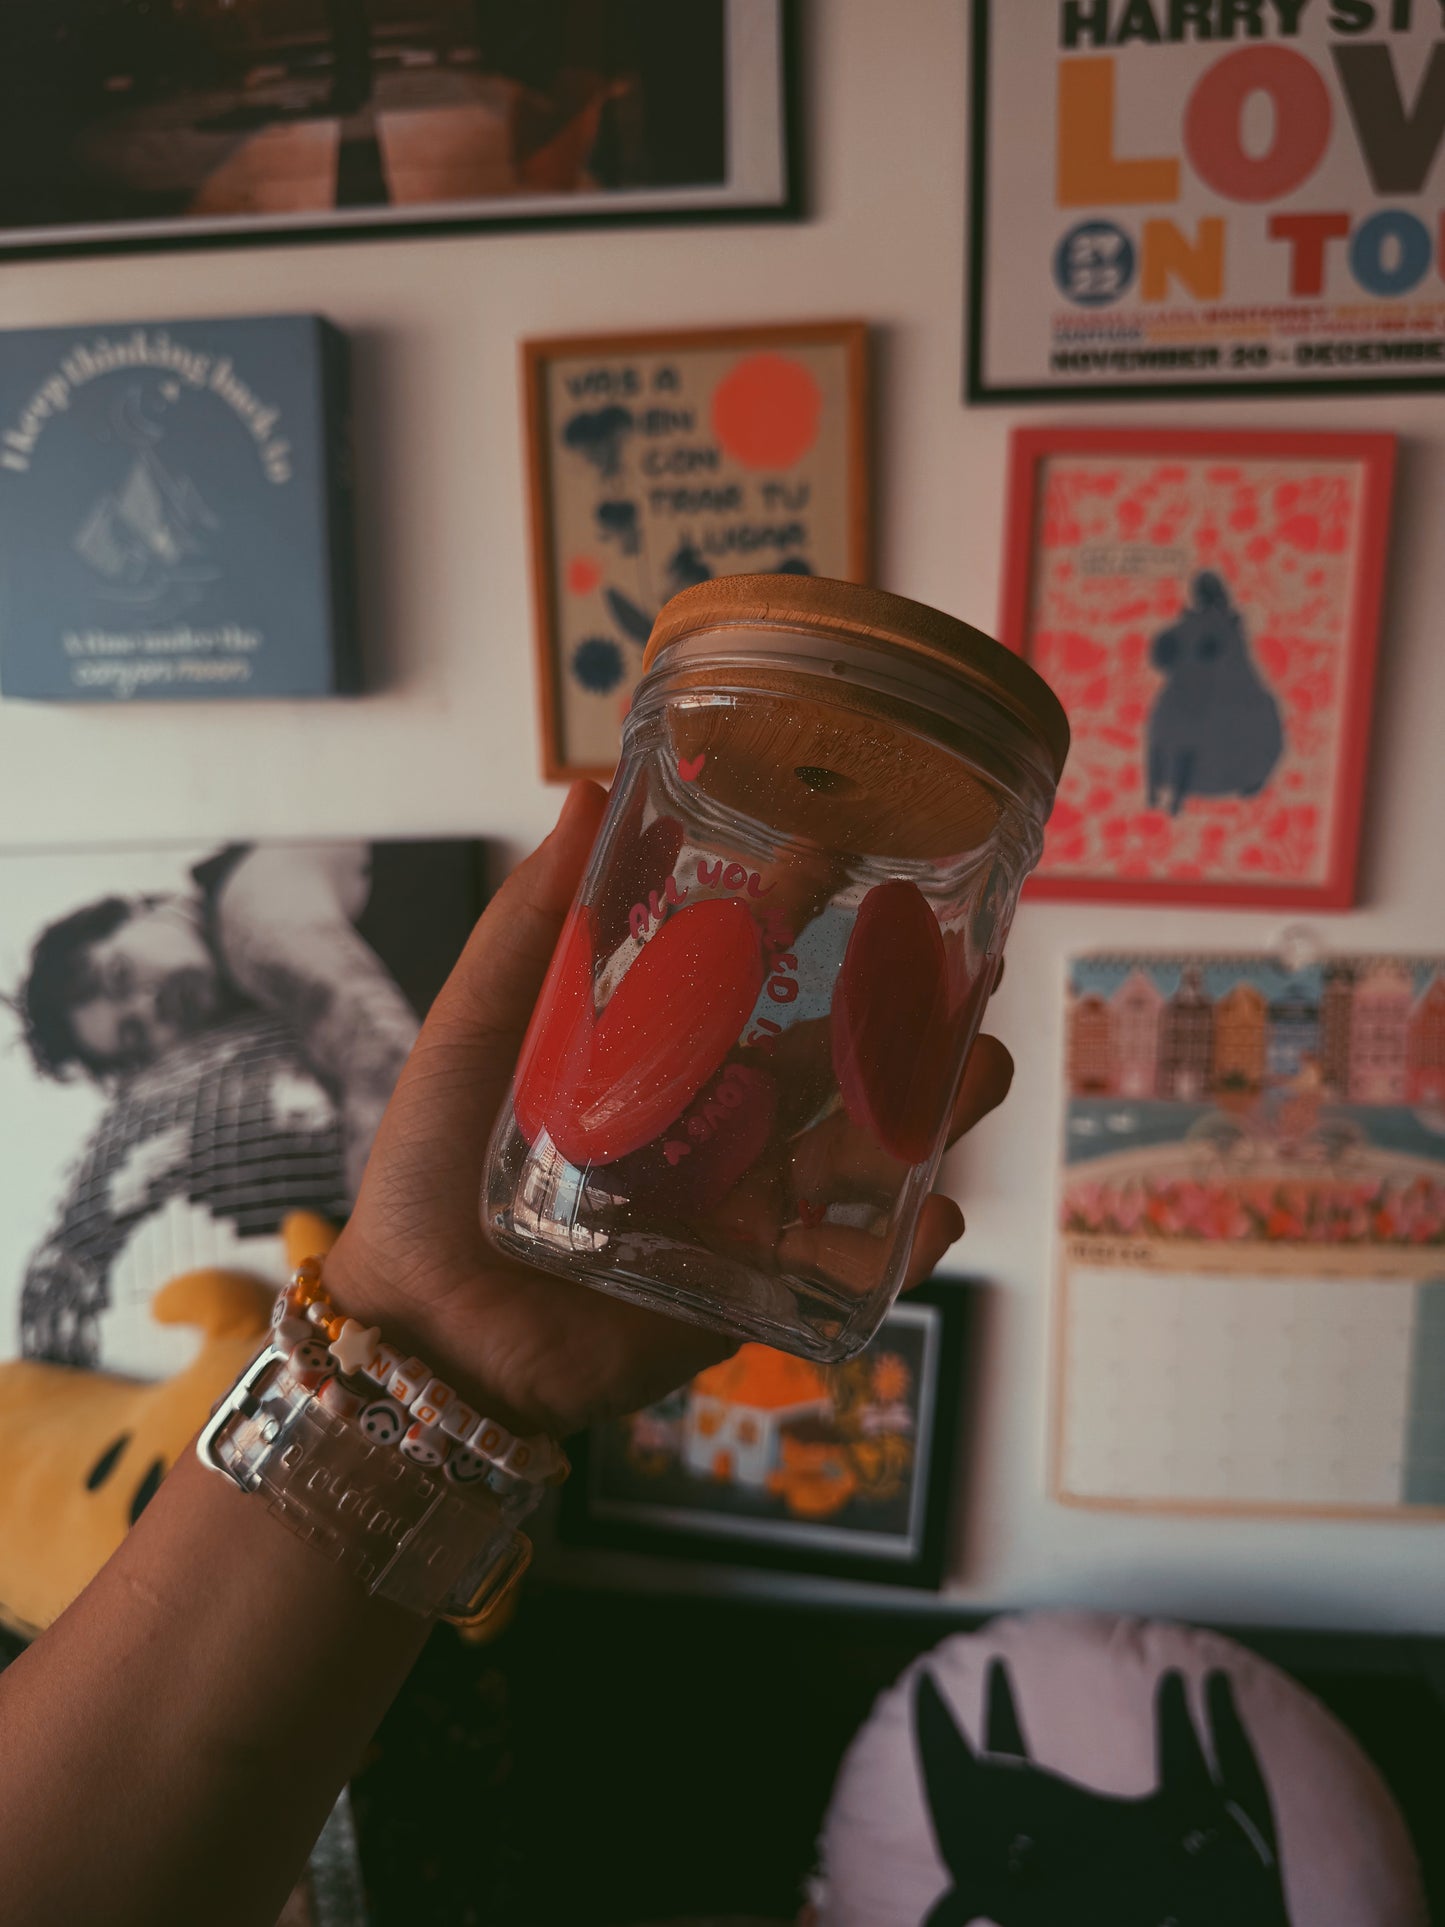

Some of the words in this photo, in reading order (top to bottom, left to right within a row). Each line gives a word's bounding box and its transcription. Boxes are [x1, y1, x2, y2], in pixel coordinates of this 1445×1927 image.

[1060, 0, 1310, 49] HARRY
[1268, 208, 1445, 298] TO
[1051, 345, 1221, 371] NOVEMBER
